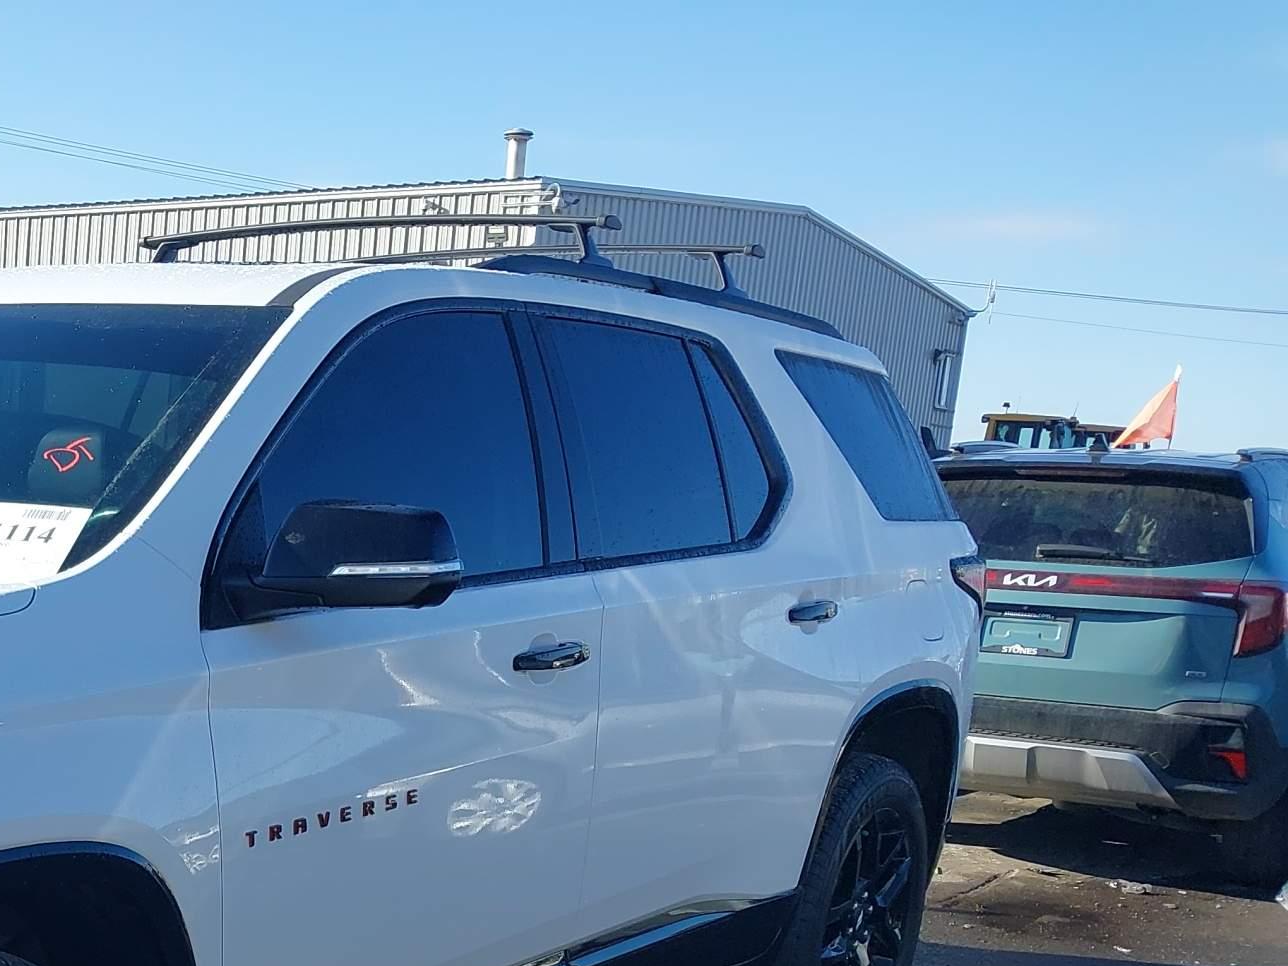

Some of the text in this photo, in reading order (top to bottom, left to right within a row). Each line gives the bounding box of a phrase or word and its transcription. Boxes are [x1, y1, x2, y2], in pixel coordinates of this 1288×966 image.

[1002, 573, 1058, 587] KIA
[1001, 644, 1038, 655] STONES
[244, 788, 419, 848] TRAVERSE
